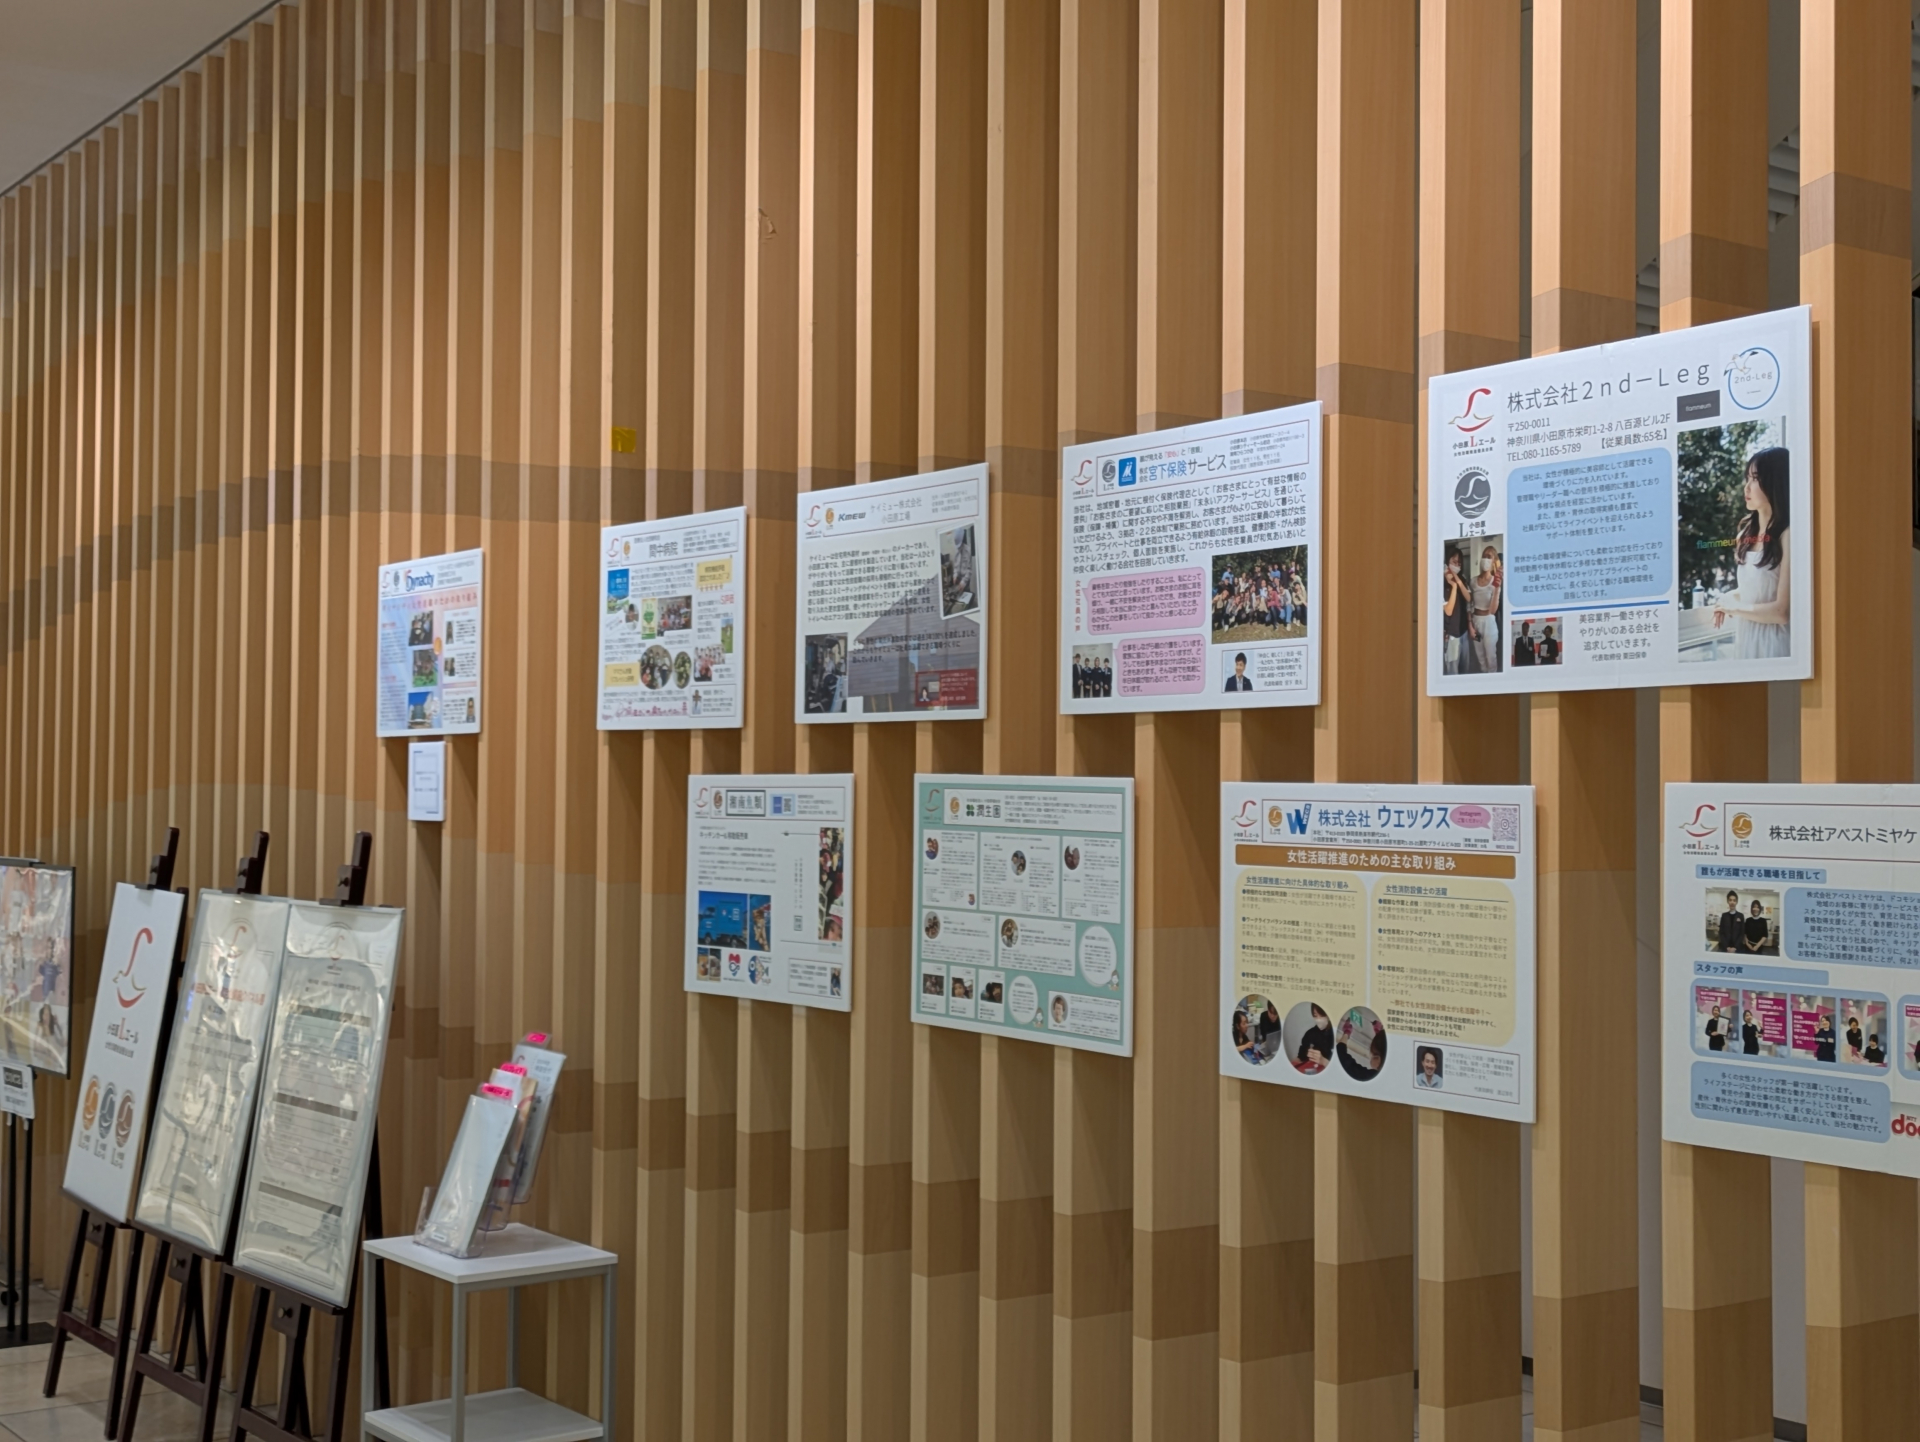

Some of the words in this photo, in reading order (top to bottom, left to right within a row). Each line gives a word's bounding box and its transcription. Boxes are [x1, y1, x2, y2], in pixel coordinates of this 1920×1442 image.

[1507, 422, 1614, 448] 神奈川県小田原市栄町1-2-8
[1615, 412, 1671, 431] 八百源ビル2F
[1507, 442, 1582, 462] TEL:080-1165-5789
[1148, 454, 1226, 482] 宮下保険サービス
[870, 497, 922, 514] ケイミュー株式会社
[1579, 623, 1660, 637] やりがいのある会社を
[1583, 638, 1652, 651] 追求していきます。
[1318, 809, 1372, 828] 株式会社
[1769, 824, 1918, 844] 株式会社アベストミヤケ
[1287, 850, 1456, 871] 女性活躍推進のための主な取り組み
[1701, 866, 1820, 880] 誰もが活躍できる職場を目指して
[1246, 876, 1349, 889] 女性活躍推進に向けた具体的な取り組み
[1386, 884, 1448, 896] 女性消防設備士の活躍
[1804, 916, 1920, 929] 資格取得支援など、長く働き続けられる
[1696, 964, 1744, 975] スタッフの声
